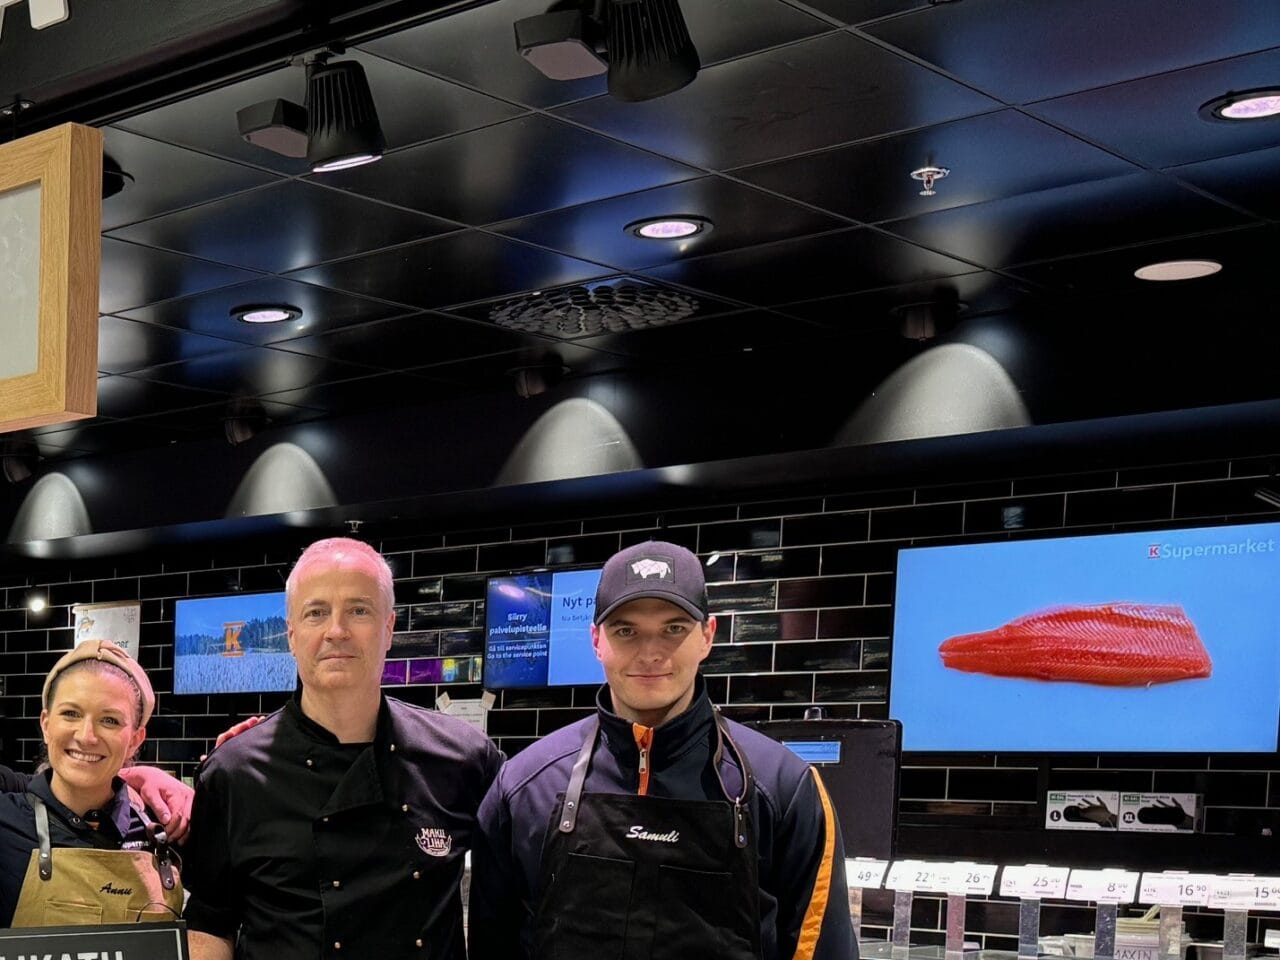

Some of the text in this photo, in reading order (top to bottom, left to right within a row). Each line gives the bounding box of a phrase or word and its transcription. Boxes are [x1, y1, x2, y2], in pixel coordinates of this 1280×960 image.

[563, 596, 582, 609] Nyt
[626, 826, 680, 843] Samuli
[1178, 884, 1194, 896] 16
[1254, 887, 1270, 899] 15
